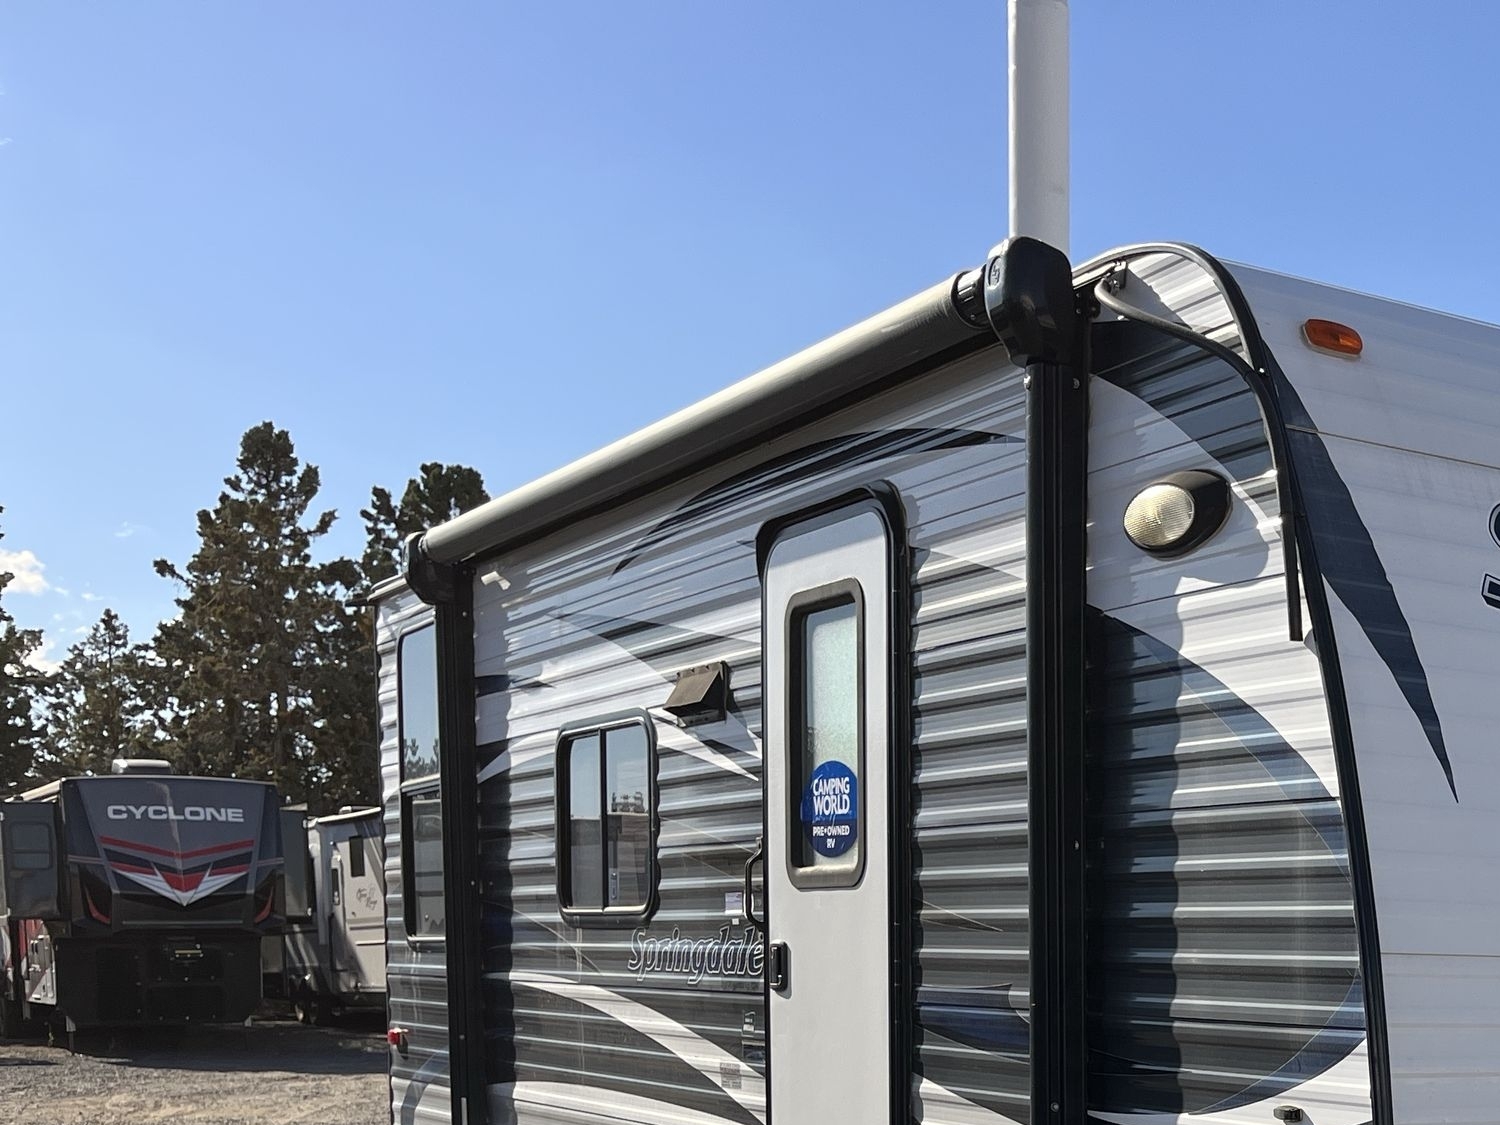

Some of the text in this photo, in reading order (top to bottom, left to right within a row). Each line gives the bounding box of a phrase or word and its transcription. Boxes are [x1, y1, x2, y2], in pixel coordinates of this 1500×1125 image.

[813, 776, 850, 796] CAMPING
[107, 805, 244, 822] CYCLONE
[813, 793, 850, 816] WORLD
[826, 838, 835, 848] RV
[627, 926, 764, 985] Springdale
